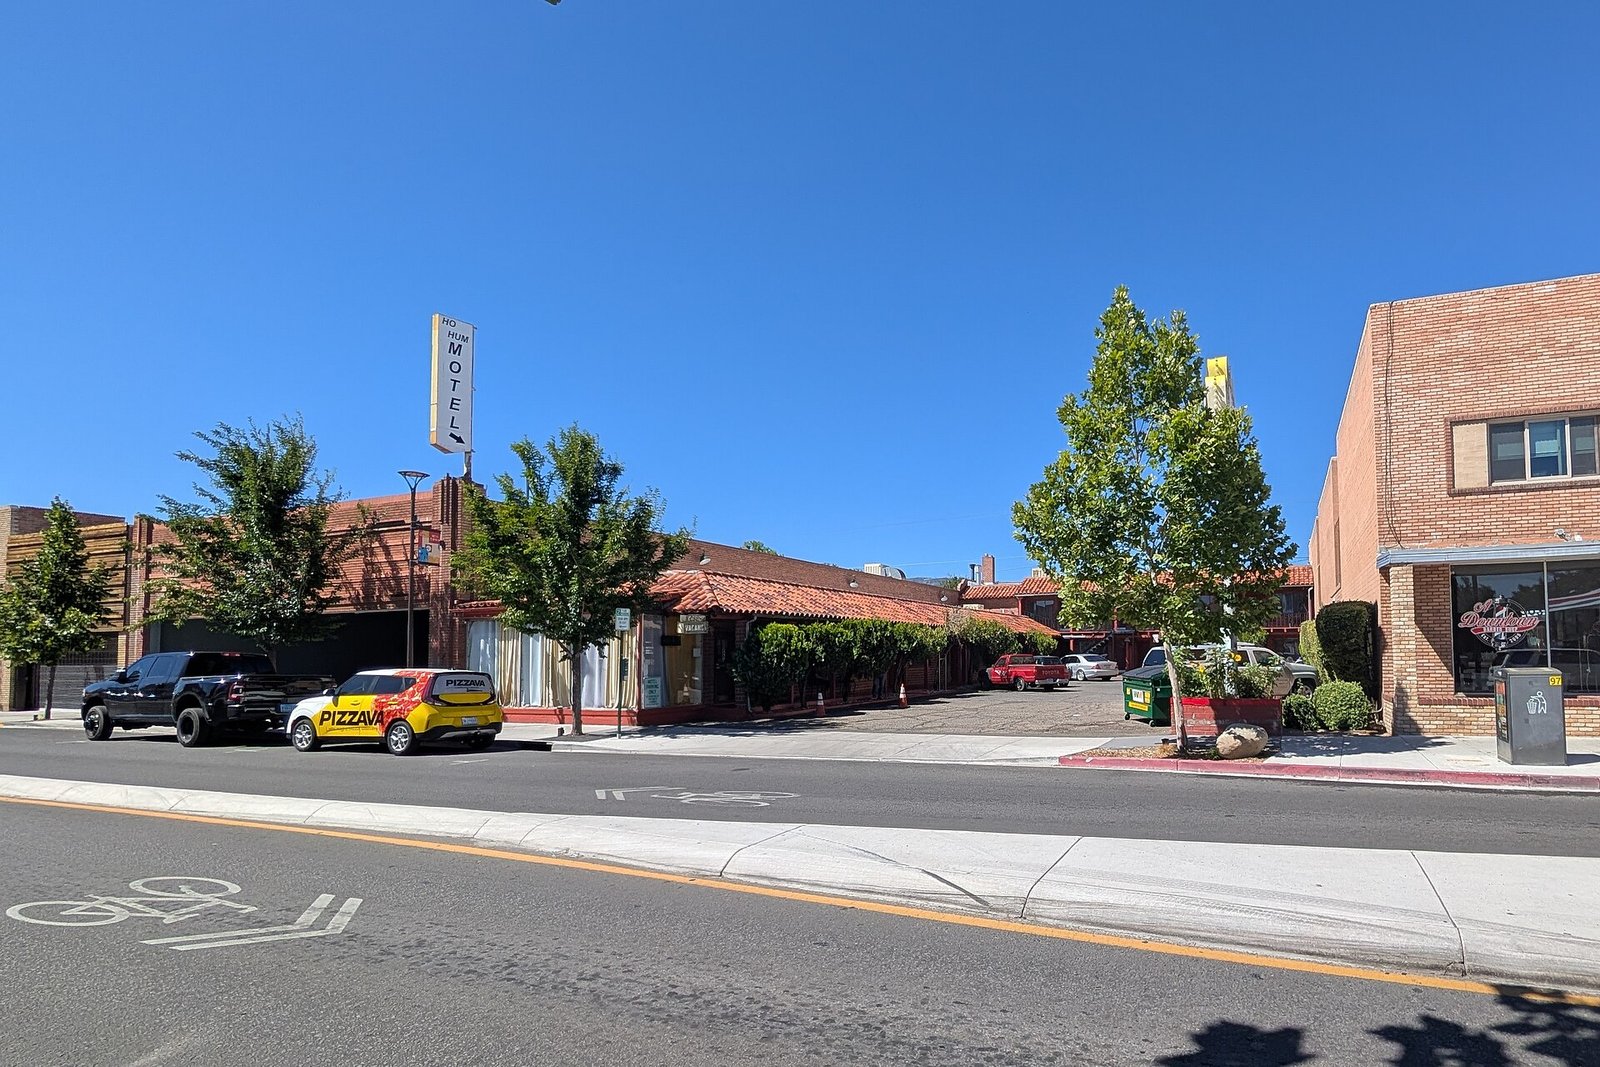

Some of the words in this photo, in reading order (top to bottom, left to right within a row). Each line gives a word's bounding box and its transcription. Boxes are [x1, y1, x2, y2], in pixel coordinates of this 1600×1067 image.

[442, 317, 457, 328] HO
[447, 330, 470, 343] HUM
[448, 341, 463, 430] MOTEL
[1458, 610, 1539, 629] Downtown
[446, 679, 486, 687] PIZZAVA
[1550, 677, 1561, 685] 97
[319, 710, 385, 726] PIZZAVA
